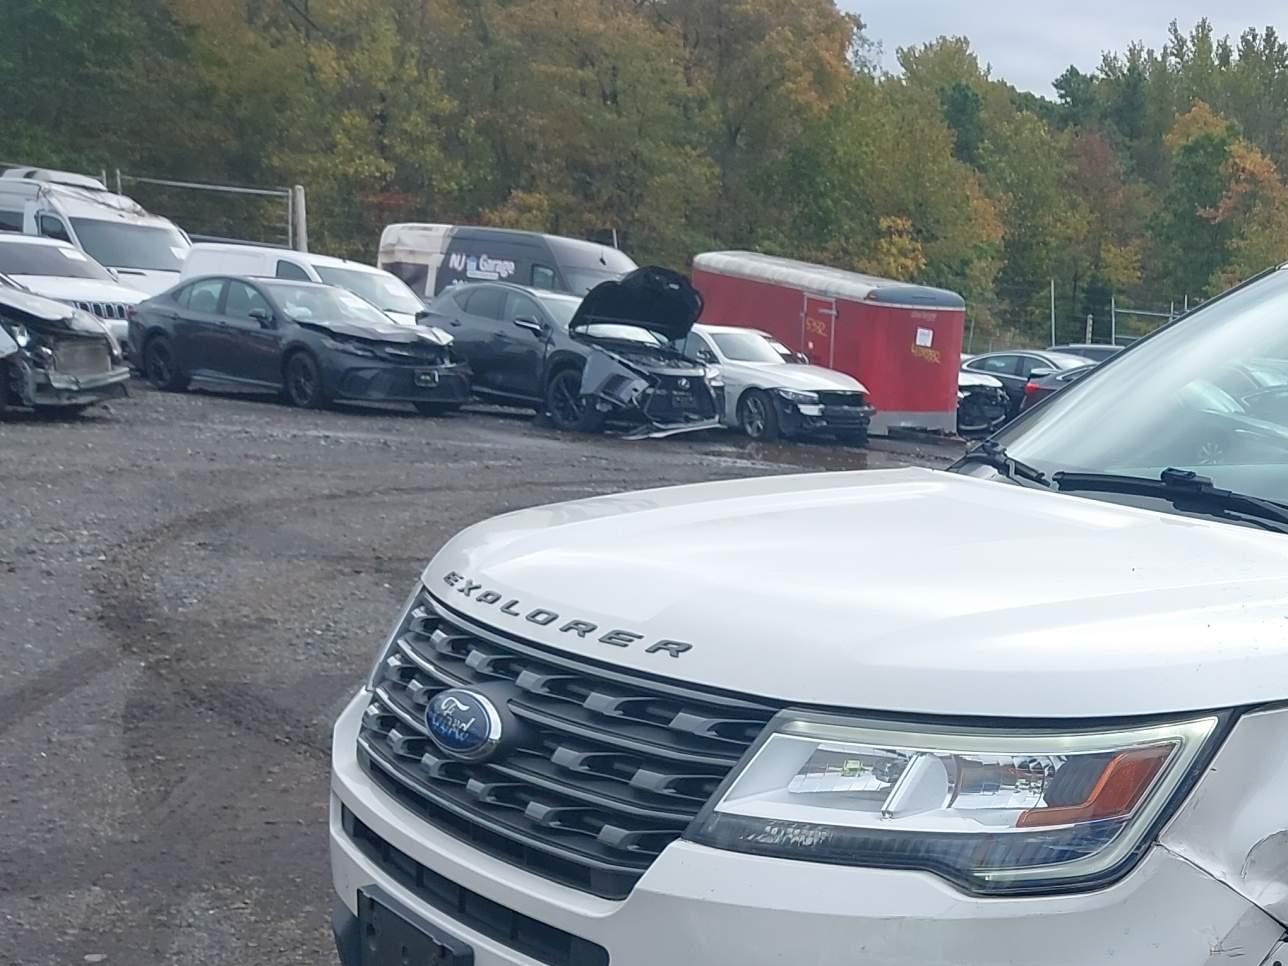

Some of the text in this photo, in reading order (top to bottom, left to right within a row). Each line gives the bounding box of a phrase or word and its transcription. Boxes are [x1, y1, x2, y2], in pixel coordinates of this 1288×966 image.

[449, 252, 466, 271] NJ
[479, 254, 515, 278] Garage
[443, 571, 695, 659] EXPLORER
[432, 696, 476, 741] Ford
